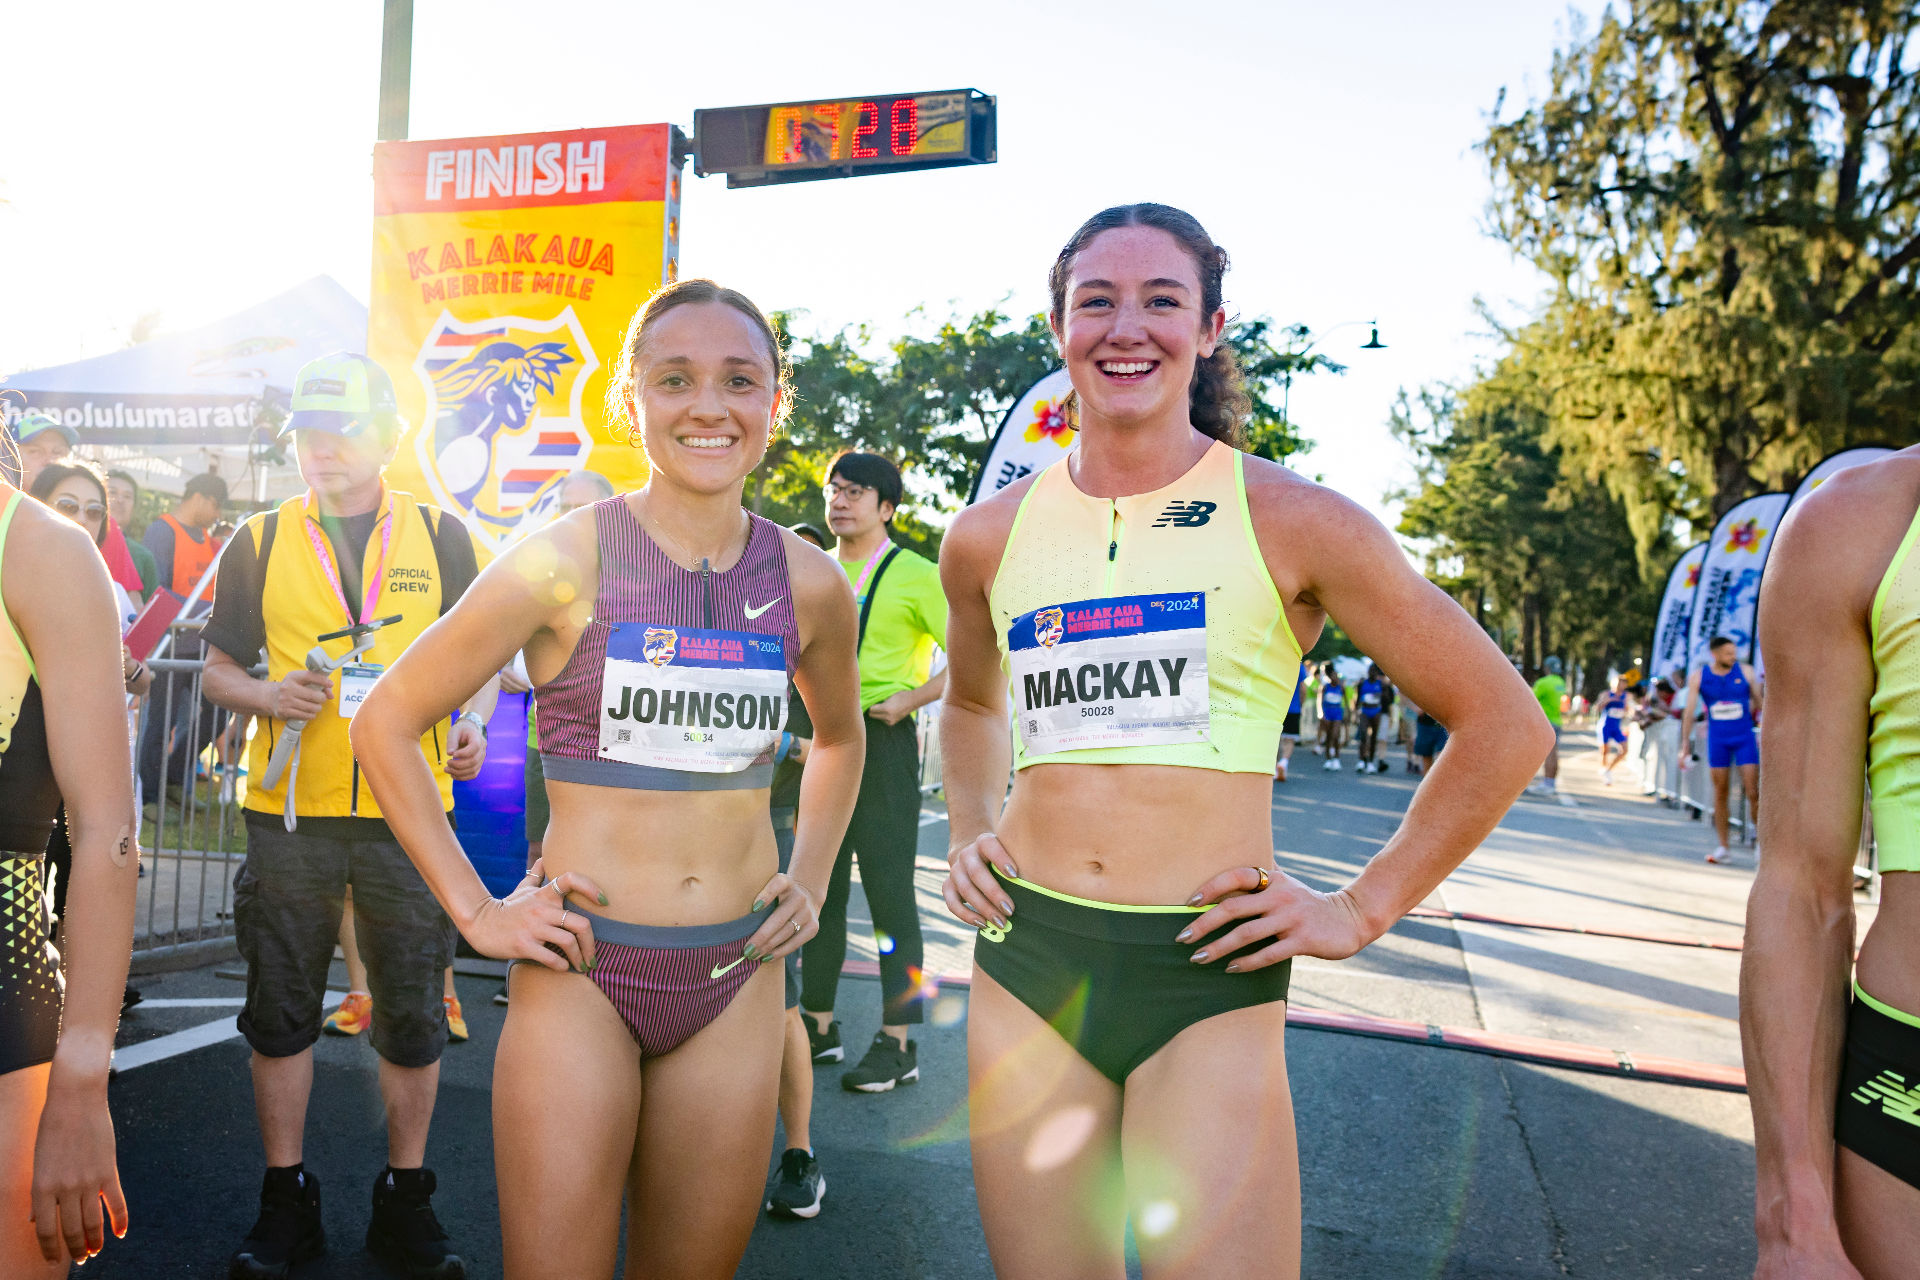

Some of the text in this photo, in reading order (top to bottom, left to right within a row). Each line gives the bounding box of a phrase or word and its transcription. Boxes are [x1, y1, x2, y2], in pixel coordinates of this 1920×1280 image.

[426, 140, 606, 200] FINISH
[407, 233, 614, 281] KALAKAUA
[421, 271, 595, 304] MERRIE MILE
[389, 568, 432, 580] OFFICIAL
[390, 582, 429, 593] CREW
[1166, 599, 1199, 612] 2024
[1067, 604, 1143, 623] KALAKAUA
[1067, 616, 1143, 634] MERRIE MILE
[680, 636, 744, 651] KALAKAUA
[760, 641, 781, 654] 2024
[679, 649, 744, 662] MERRIE MILE
[1023, 657, 1188, 711] MACKAY
[607, 685, 782, 731] JOHNSON
[1081, 705, 1115, 717] 50028
[683, 732, 714, 743] 50034
